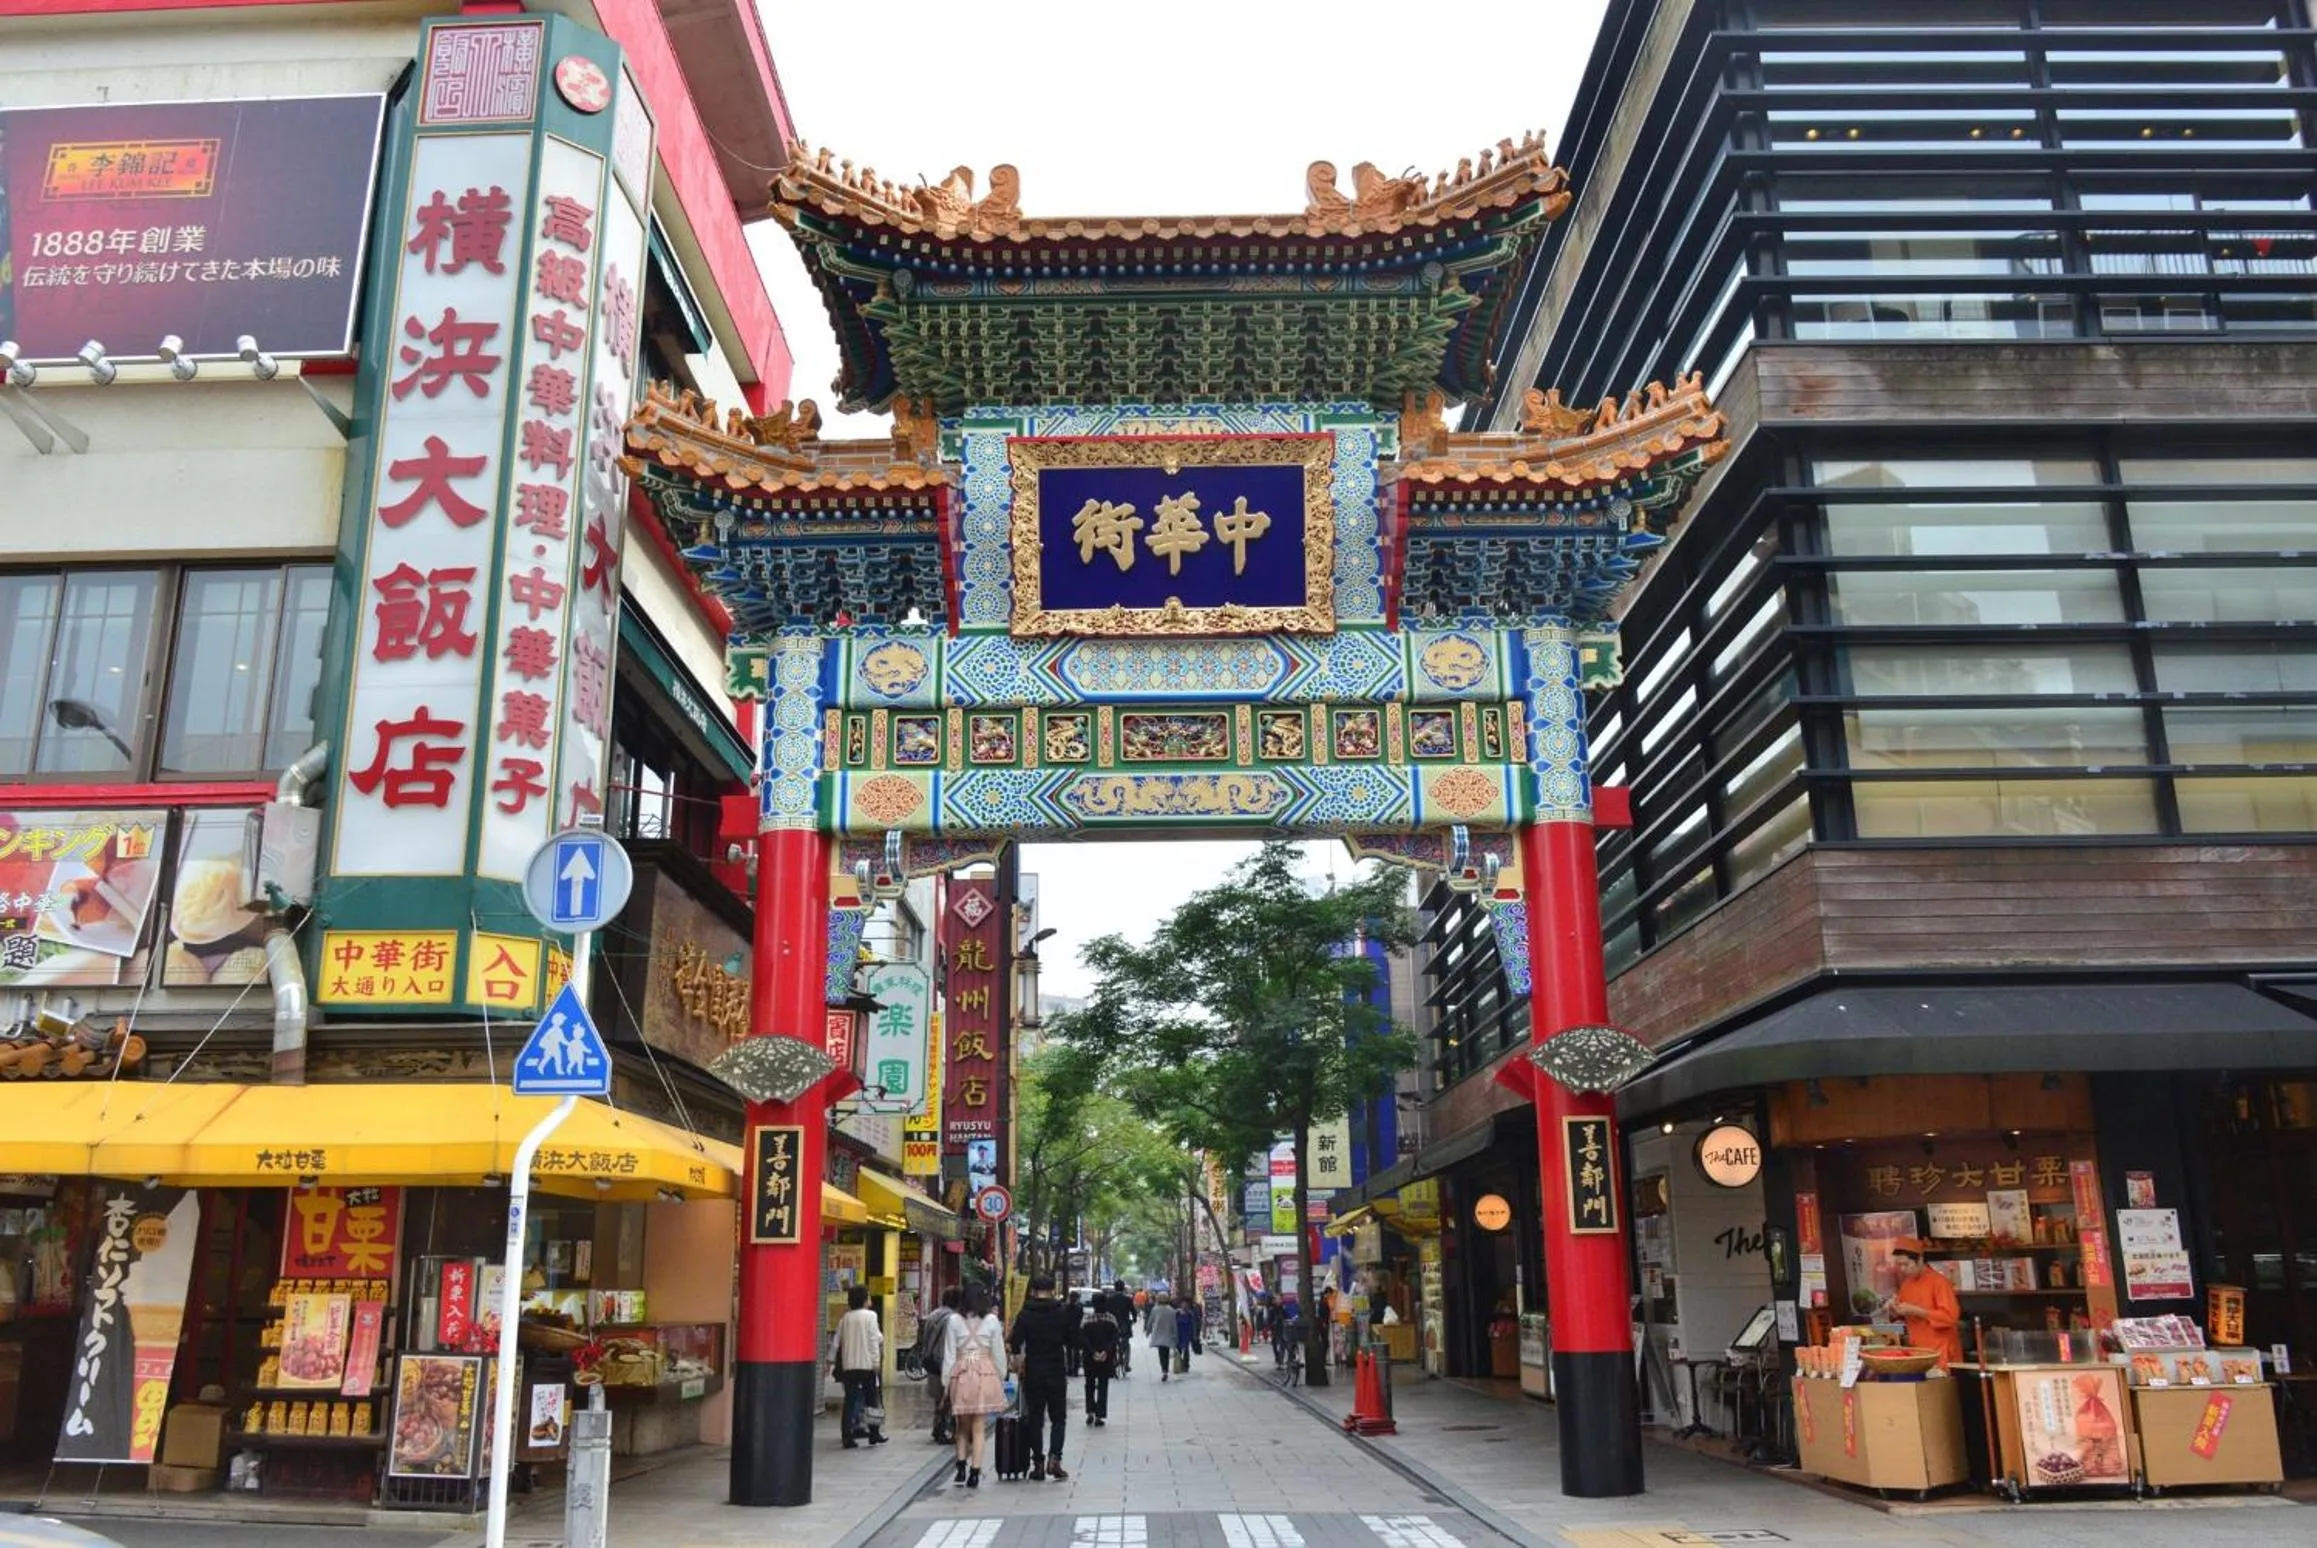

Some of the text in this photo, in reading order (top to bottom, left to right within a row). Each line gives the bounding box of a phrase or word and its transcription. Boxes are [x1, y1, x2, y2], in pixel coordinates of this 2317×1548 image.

[90, 151, 178, 177] 李錦記
[31, 226, 207, 257] 1888年創業
[22, 256, 343, 288] 伝統を守り続けてきた本場の味
[349, 185, 513, 809] 横浜大飯店
[1072, 491, 1272, 575] 中華街
[334, 938, 450, 973] 中華街
[482, 943, 528, 1000] 入口
[331, 974, 445, 996] 大通り入口
[949, 939, 995, 1107] 龍州飯店
[877, 1003, 915, 1094] 楽園
[949, 1120, 992, 1131] RYUSYU
[1317, 1134, 1338, 1173] 新館
[1725, 1147, 1758, 1166] CAFE
[1866, 1155, 2070, 1197] 聘珍大甘栗
[984, 1197, 1004, 1213] 30
[66, 1192, 138, 1437] 杏仁ソフトクリーム
